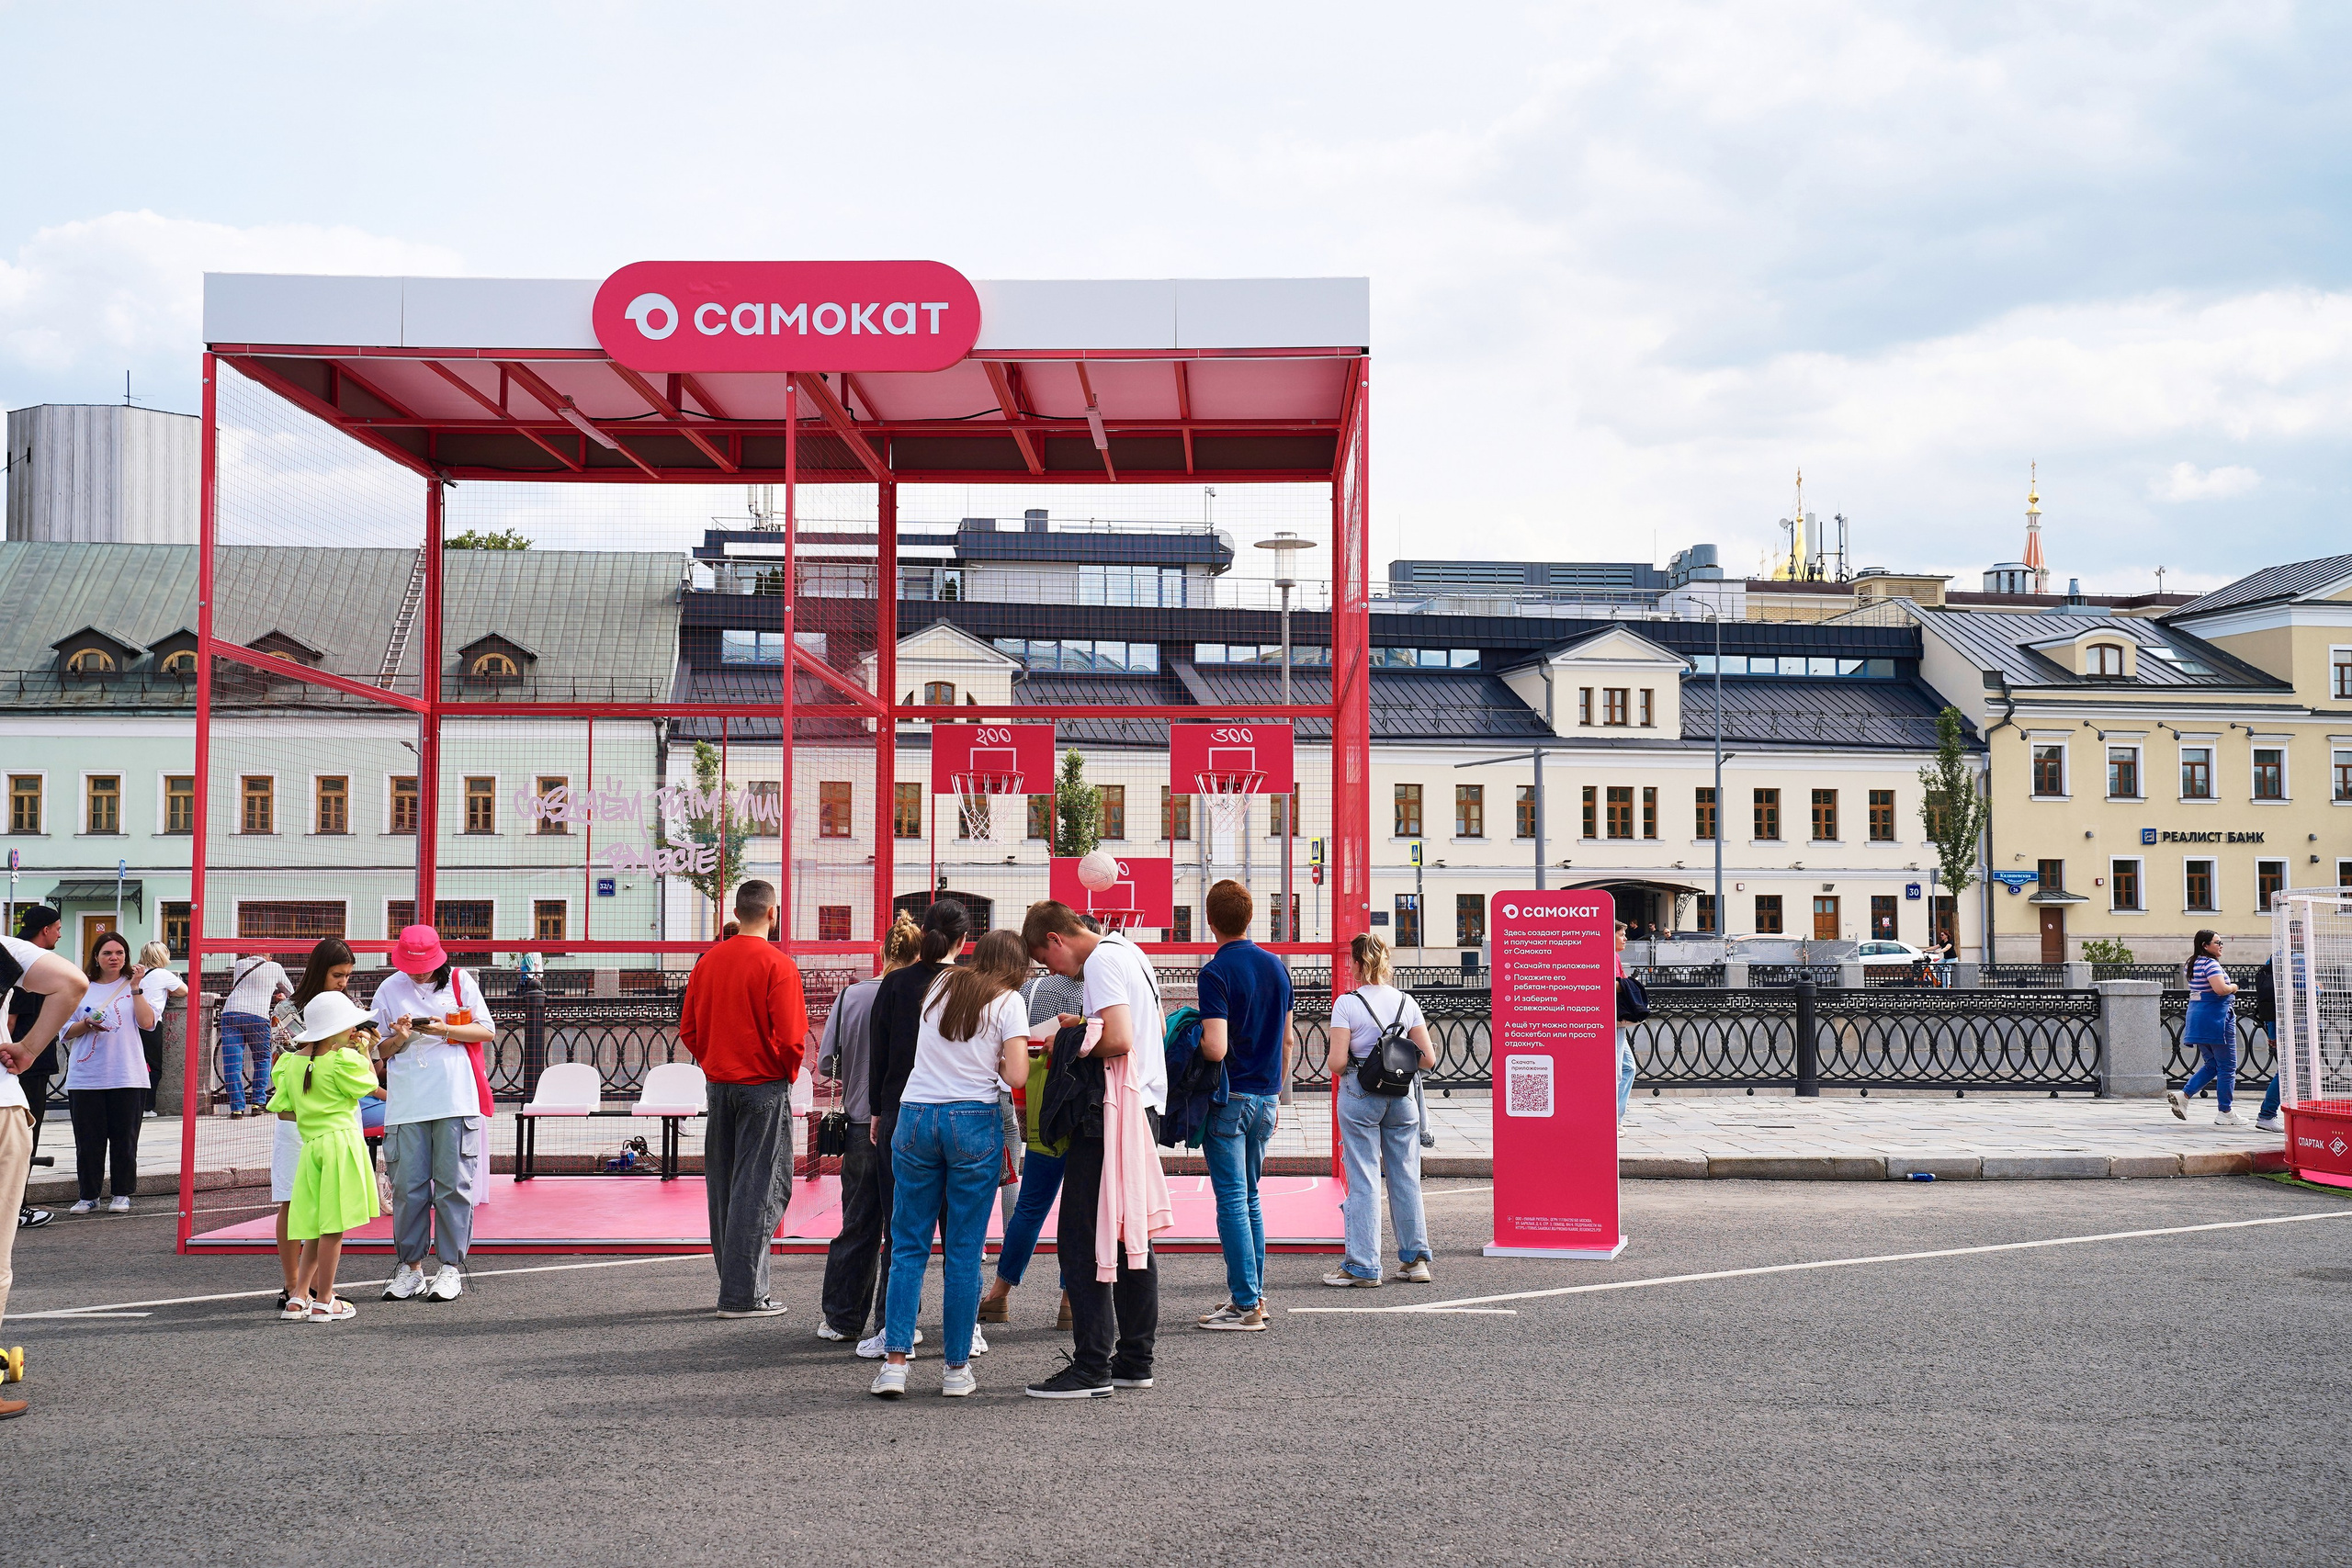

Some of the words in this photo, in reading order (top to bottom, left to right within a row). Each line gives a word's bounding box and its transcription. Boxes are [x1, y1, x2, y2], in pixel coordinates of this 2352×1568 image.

[694, 301, 949, 335] самокат
[976, 728, 1012, 746] 200
[1210, 727, 1253, 743] 300
[2163, 831, 2222, 842] РЕАЛИСТ
[2227, 831, 2265, 843] БАНК
[1909, 888, 1919, 897] 30
[1522, 907, 1600, 917] самокат
[2298, 1136, 2324, 1149] СПАРТАК
